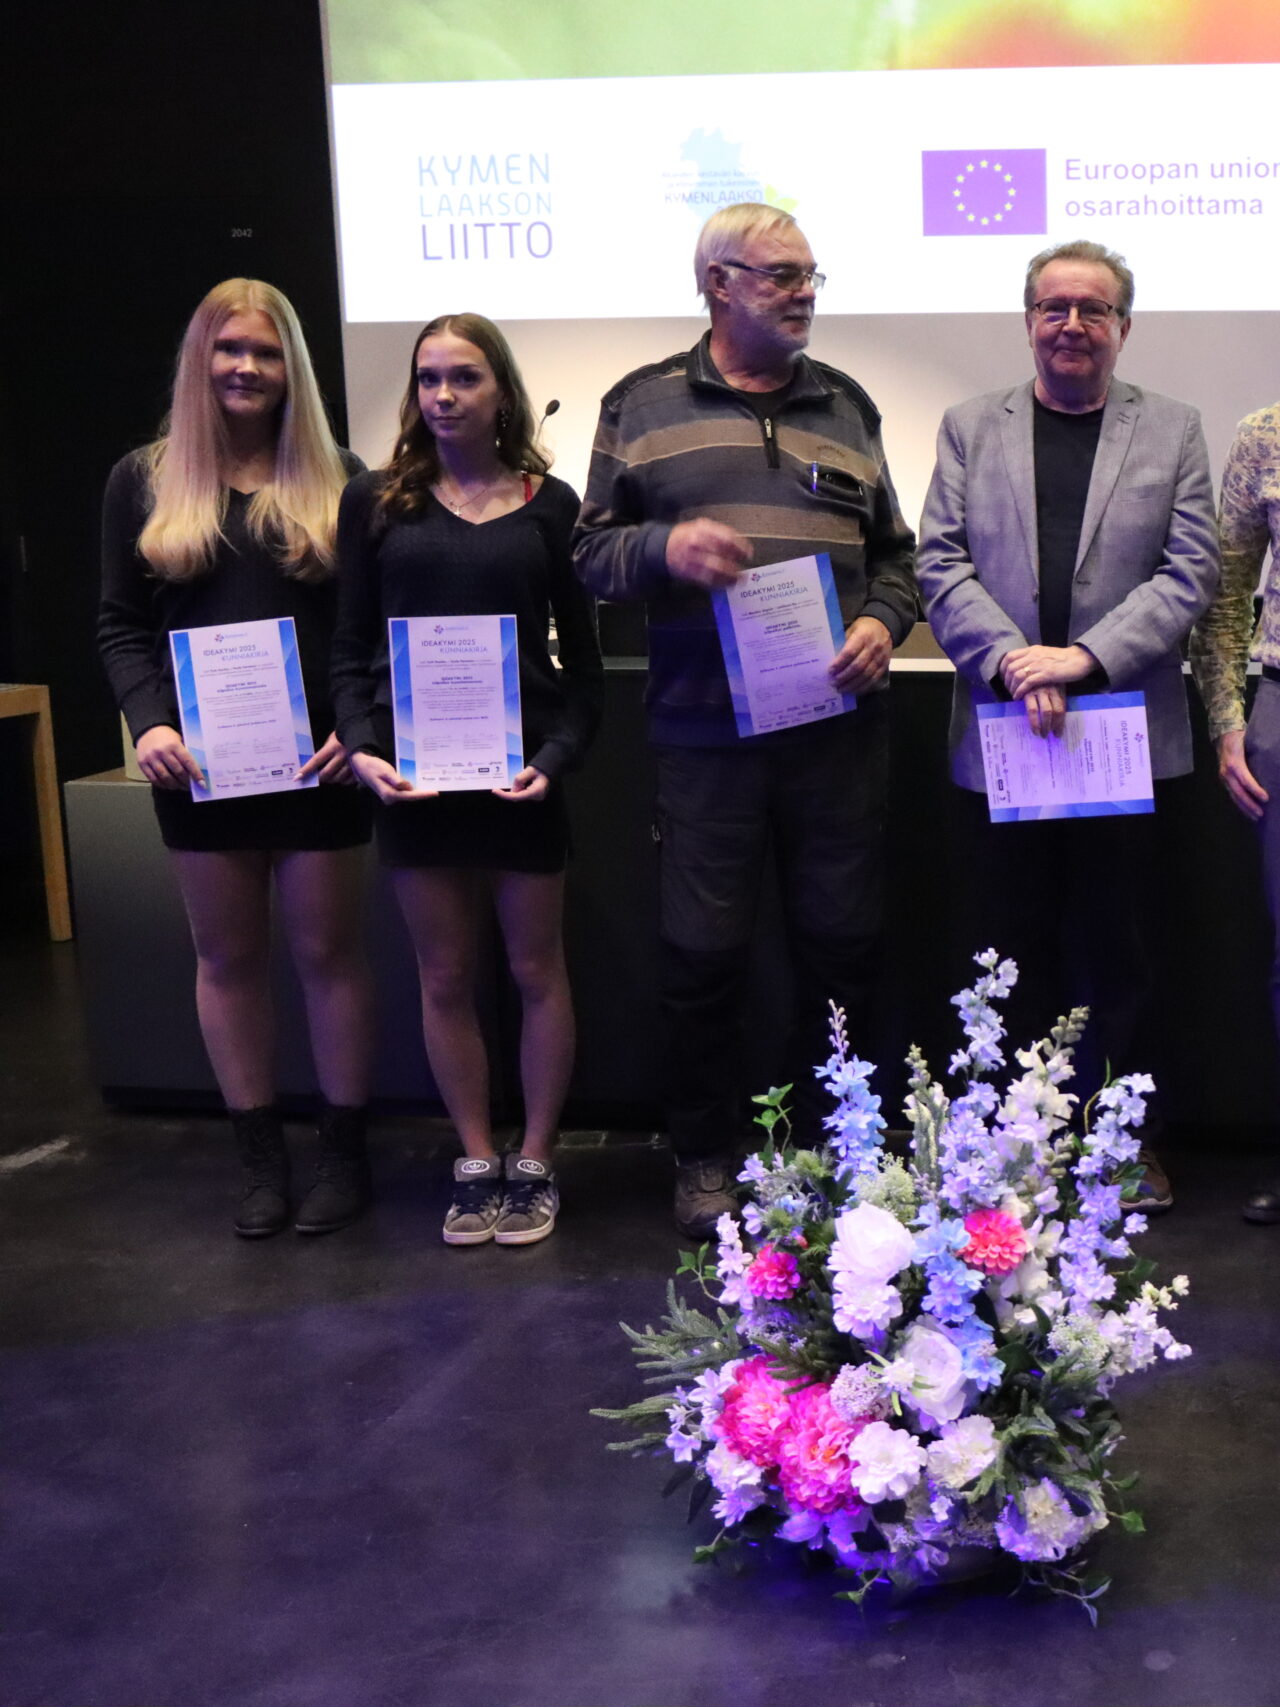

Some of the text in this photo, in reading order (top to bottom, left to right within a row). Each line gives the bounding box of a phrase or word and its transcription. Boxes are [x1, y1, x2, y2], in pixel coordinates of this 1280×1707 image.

[418, 153, 550, 187] KYMEN
[1065, 158, 1199, 185] Euroopan
[419, 192, 552, 218] LAAKSON
[1065, 194, 1264, 217] osarahoittama
[421, 221, 553, 261] LIITTO
[740, 580, 796, 599] IDEAKYMI 2025
[421, 638, 476, 648] IDEAKYMI 2025
